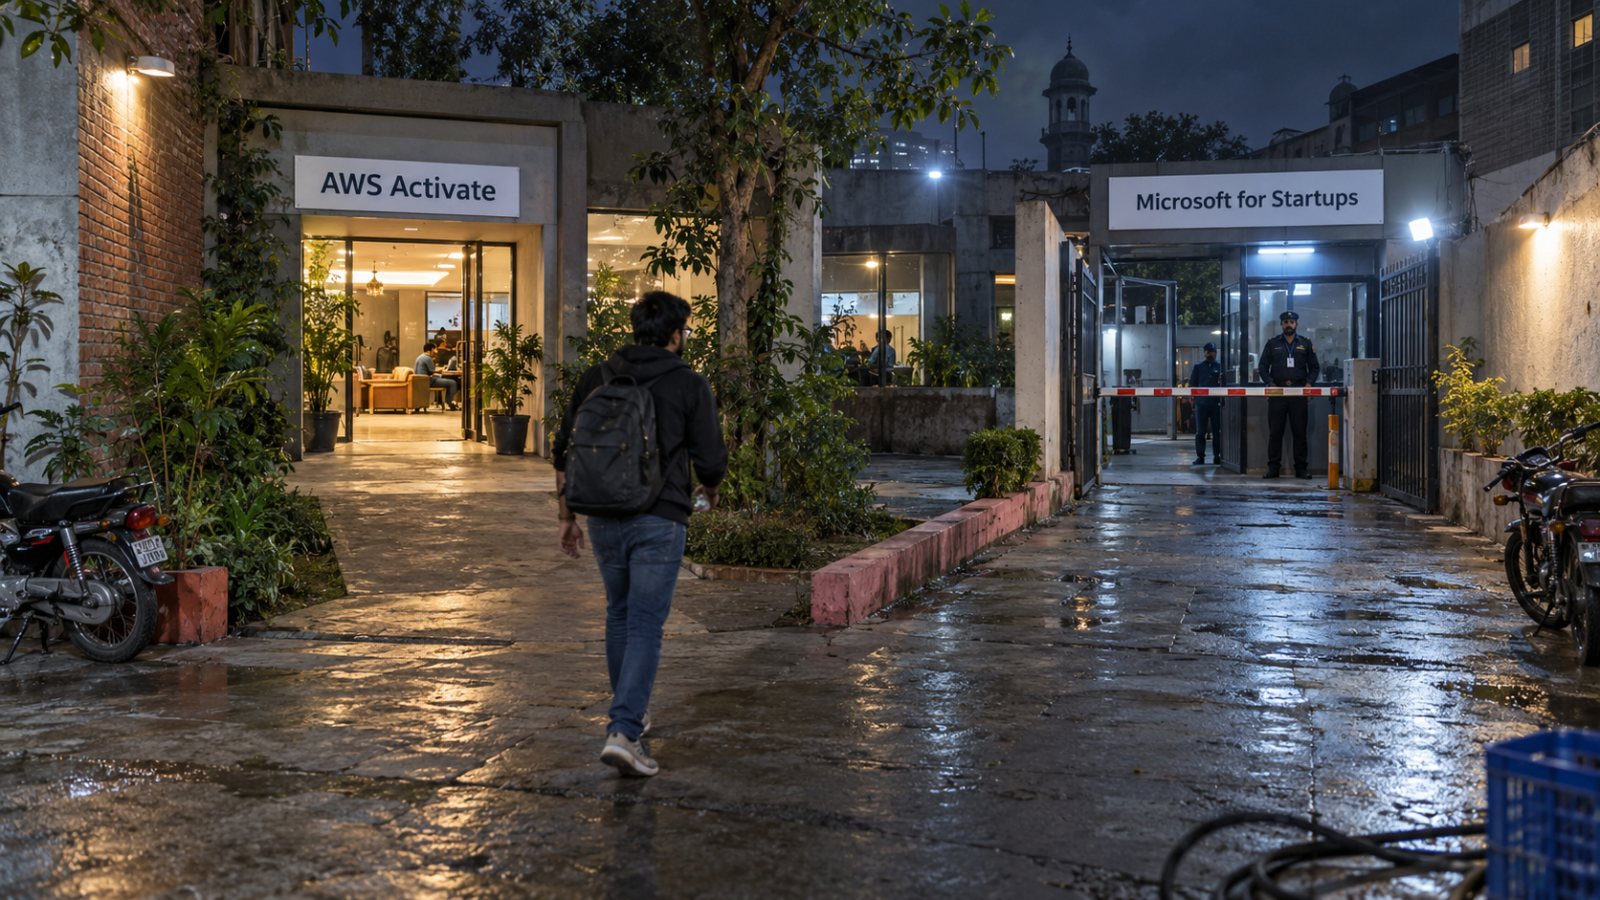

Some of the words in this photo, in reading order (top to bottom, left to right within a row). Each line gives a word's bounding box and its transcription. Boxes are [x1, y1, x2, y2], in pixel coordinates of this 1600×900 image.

[321, 171, 383, 196] AWS
[390, 175, 496, 202] Activate
[1136, 190, 1232, 211] Microsoft
[1236, 190, 1267, 209] for
[1271, 189, 1359, 211] Startups
